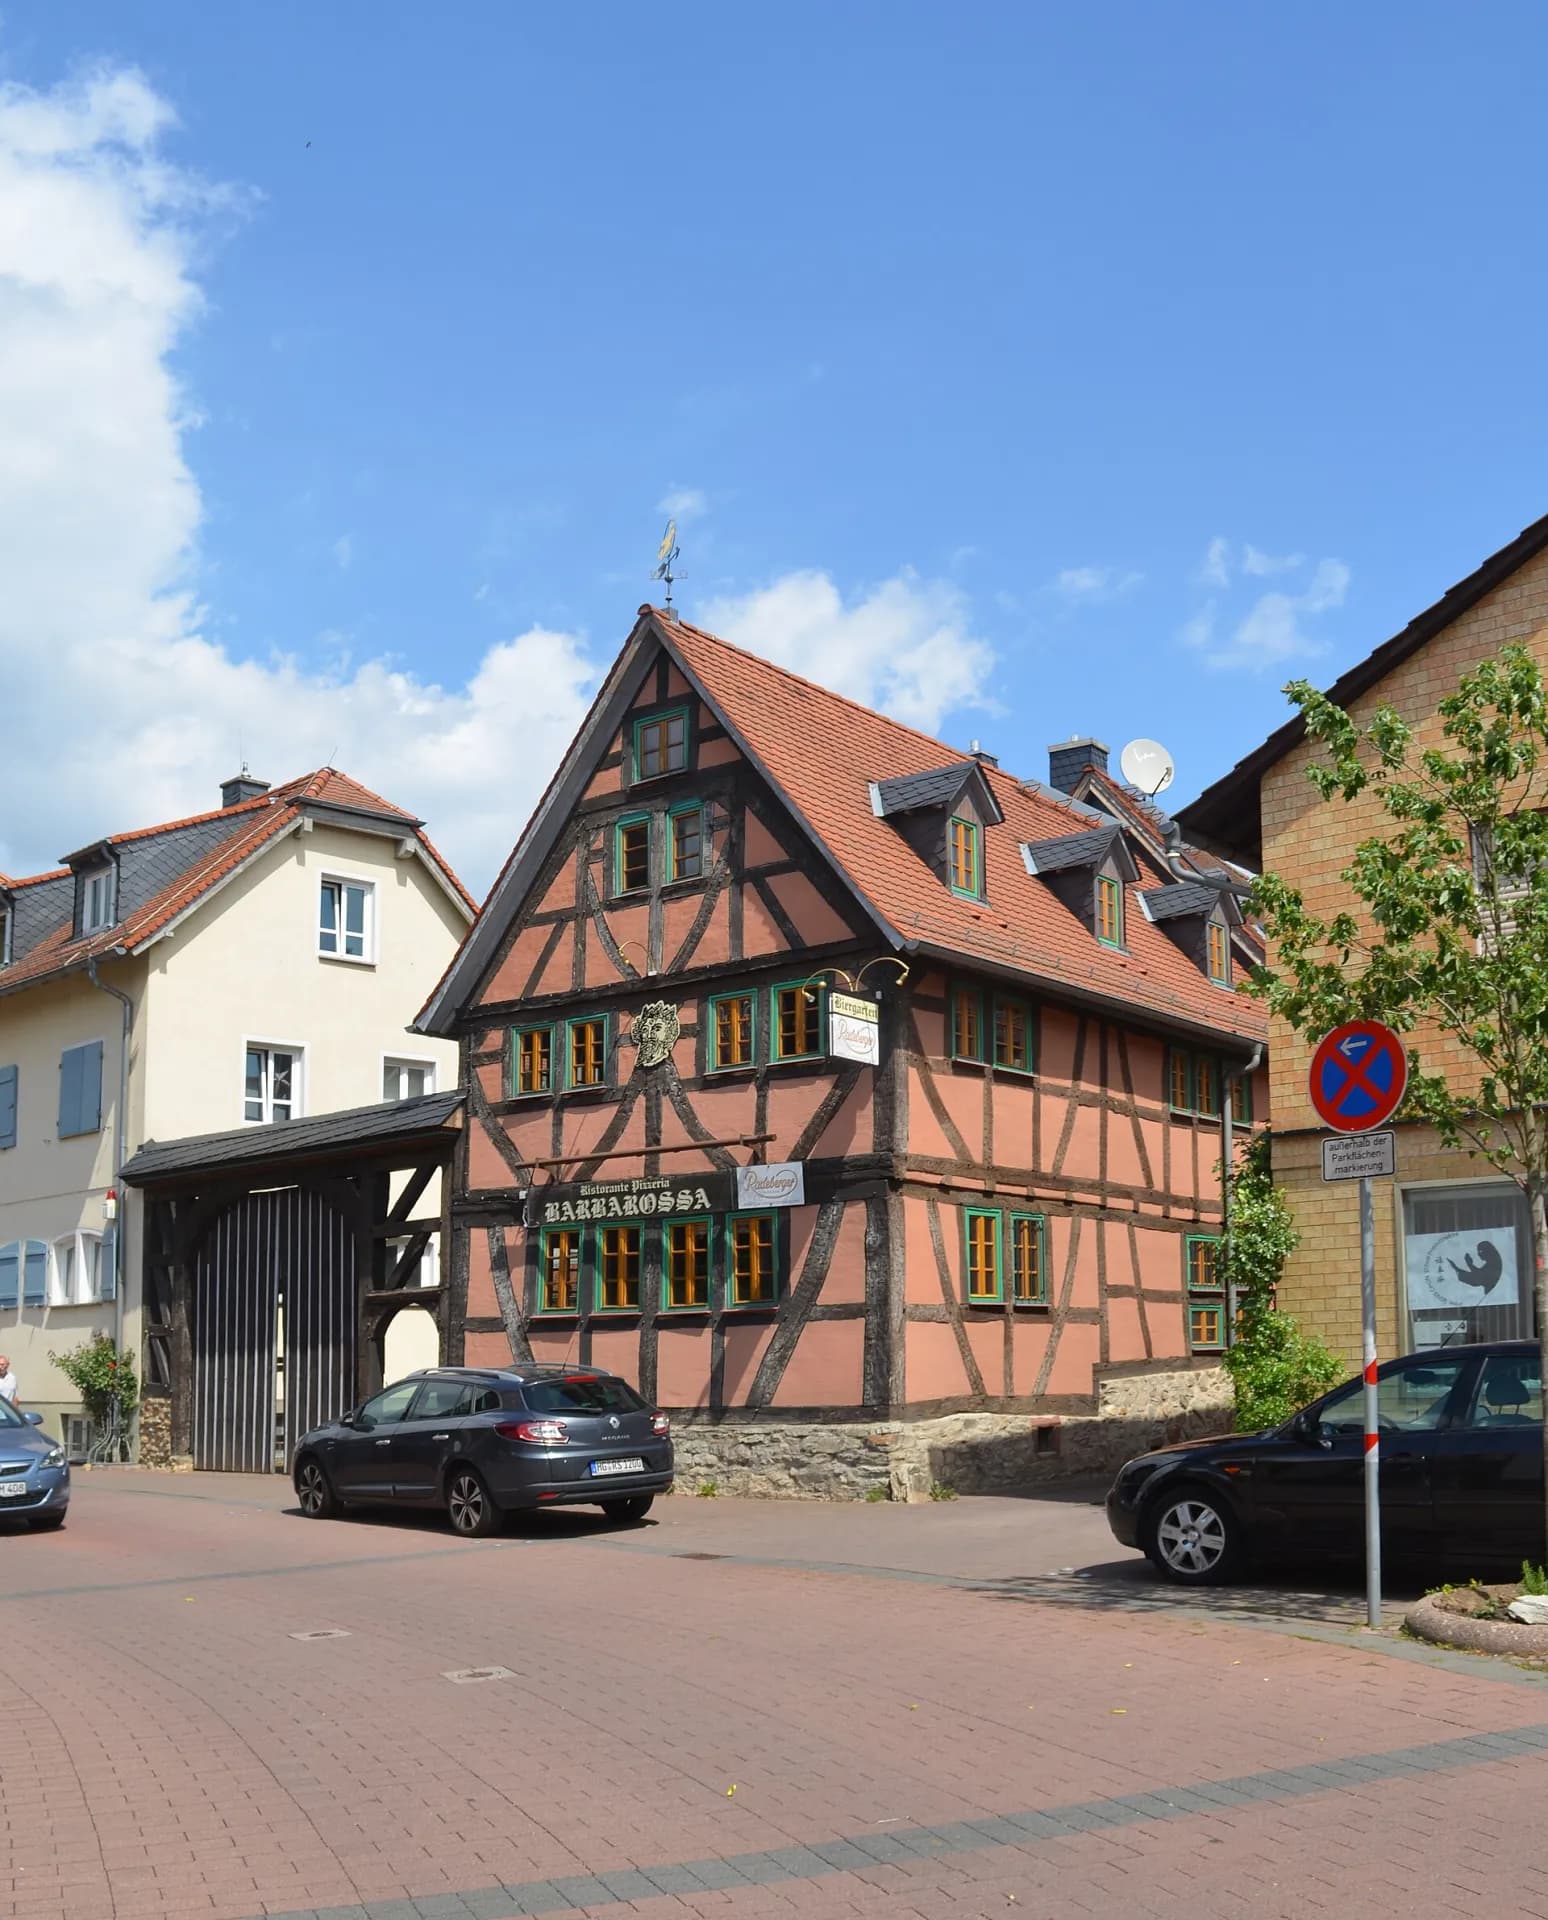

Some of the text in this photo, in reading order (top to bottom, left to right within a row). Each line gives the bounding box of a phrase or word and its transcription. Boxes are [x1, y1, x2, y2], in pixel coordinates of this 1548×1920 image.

[834, 996, 878, 1018] Biergarten
[1373, 1136, 1387, 1146] der
[580, 1177, 670, 1196] Ristorante Pizzeria
[744, 1170, 797, 1193] Radeberger
[544, 1187, 712, 1223] BARBAROSSA
